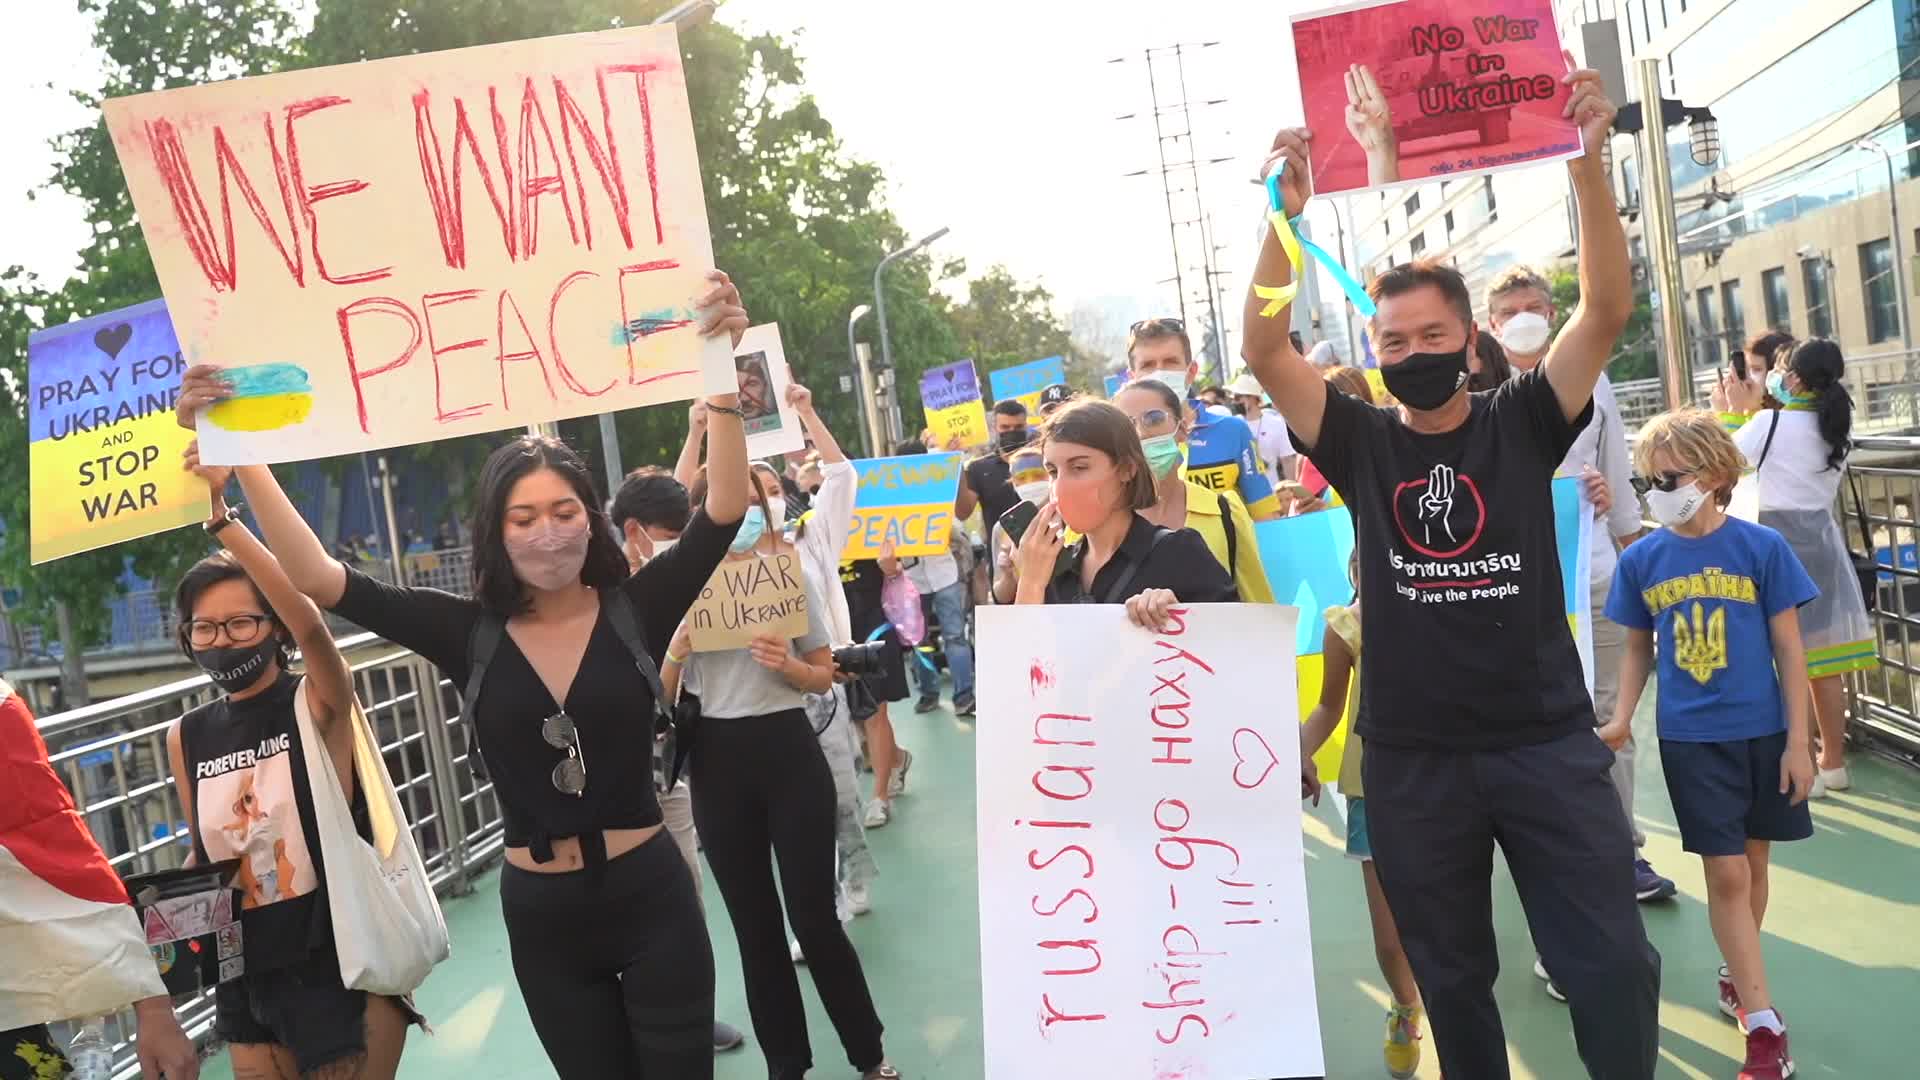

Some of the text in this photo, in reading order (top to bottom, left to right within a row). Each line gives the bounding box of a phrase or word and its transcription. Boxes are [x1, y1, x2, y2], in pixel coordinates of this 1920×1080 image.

[1412, 15, 1540, 56] No War
[1418, 73, 1555, 117] Ukraine
[145, 63, 661, 292] WE WANT
[336, 258, 700, 434] PEACE
[39, 367, 121, 410] PRAY
[101, 430, 134, 449] AND
[79, 445, 159, 487] STOP
[81, 482, 158, 523] WAR
[847, 511, 948, 548] PEACE
[723, 554, 799, 597] WAR
[1445, 590, 1468, 602] the
[1471, 582, 1521, 600] People
[1642, 567, 1758, 616] УКРАЇНА
[196, 748, 256, 779] FOREVER
[1014, 712, 1106, 1028] russian
[1142, 924, 1229, 1046] ship
